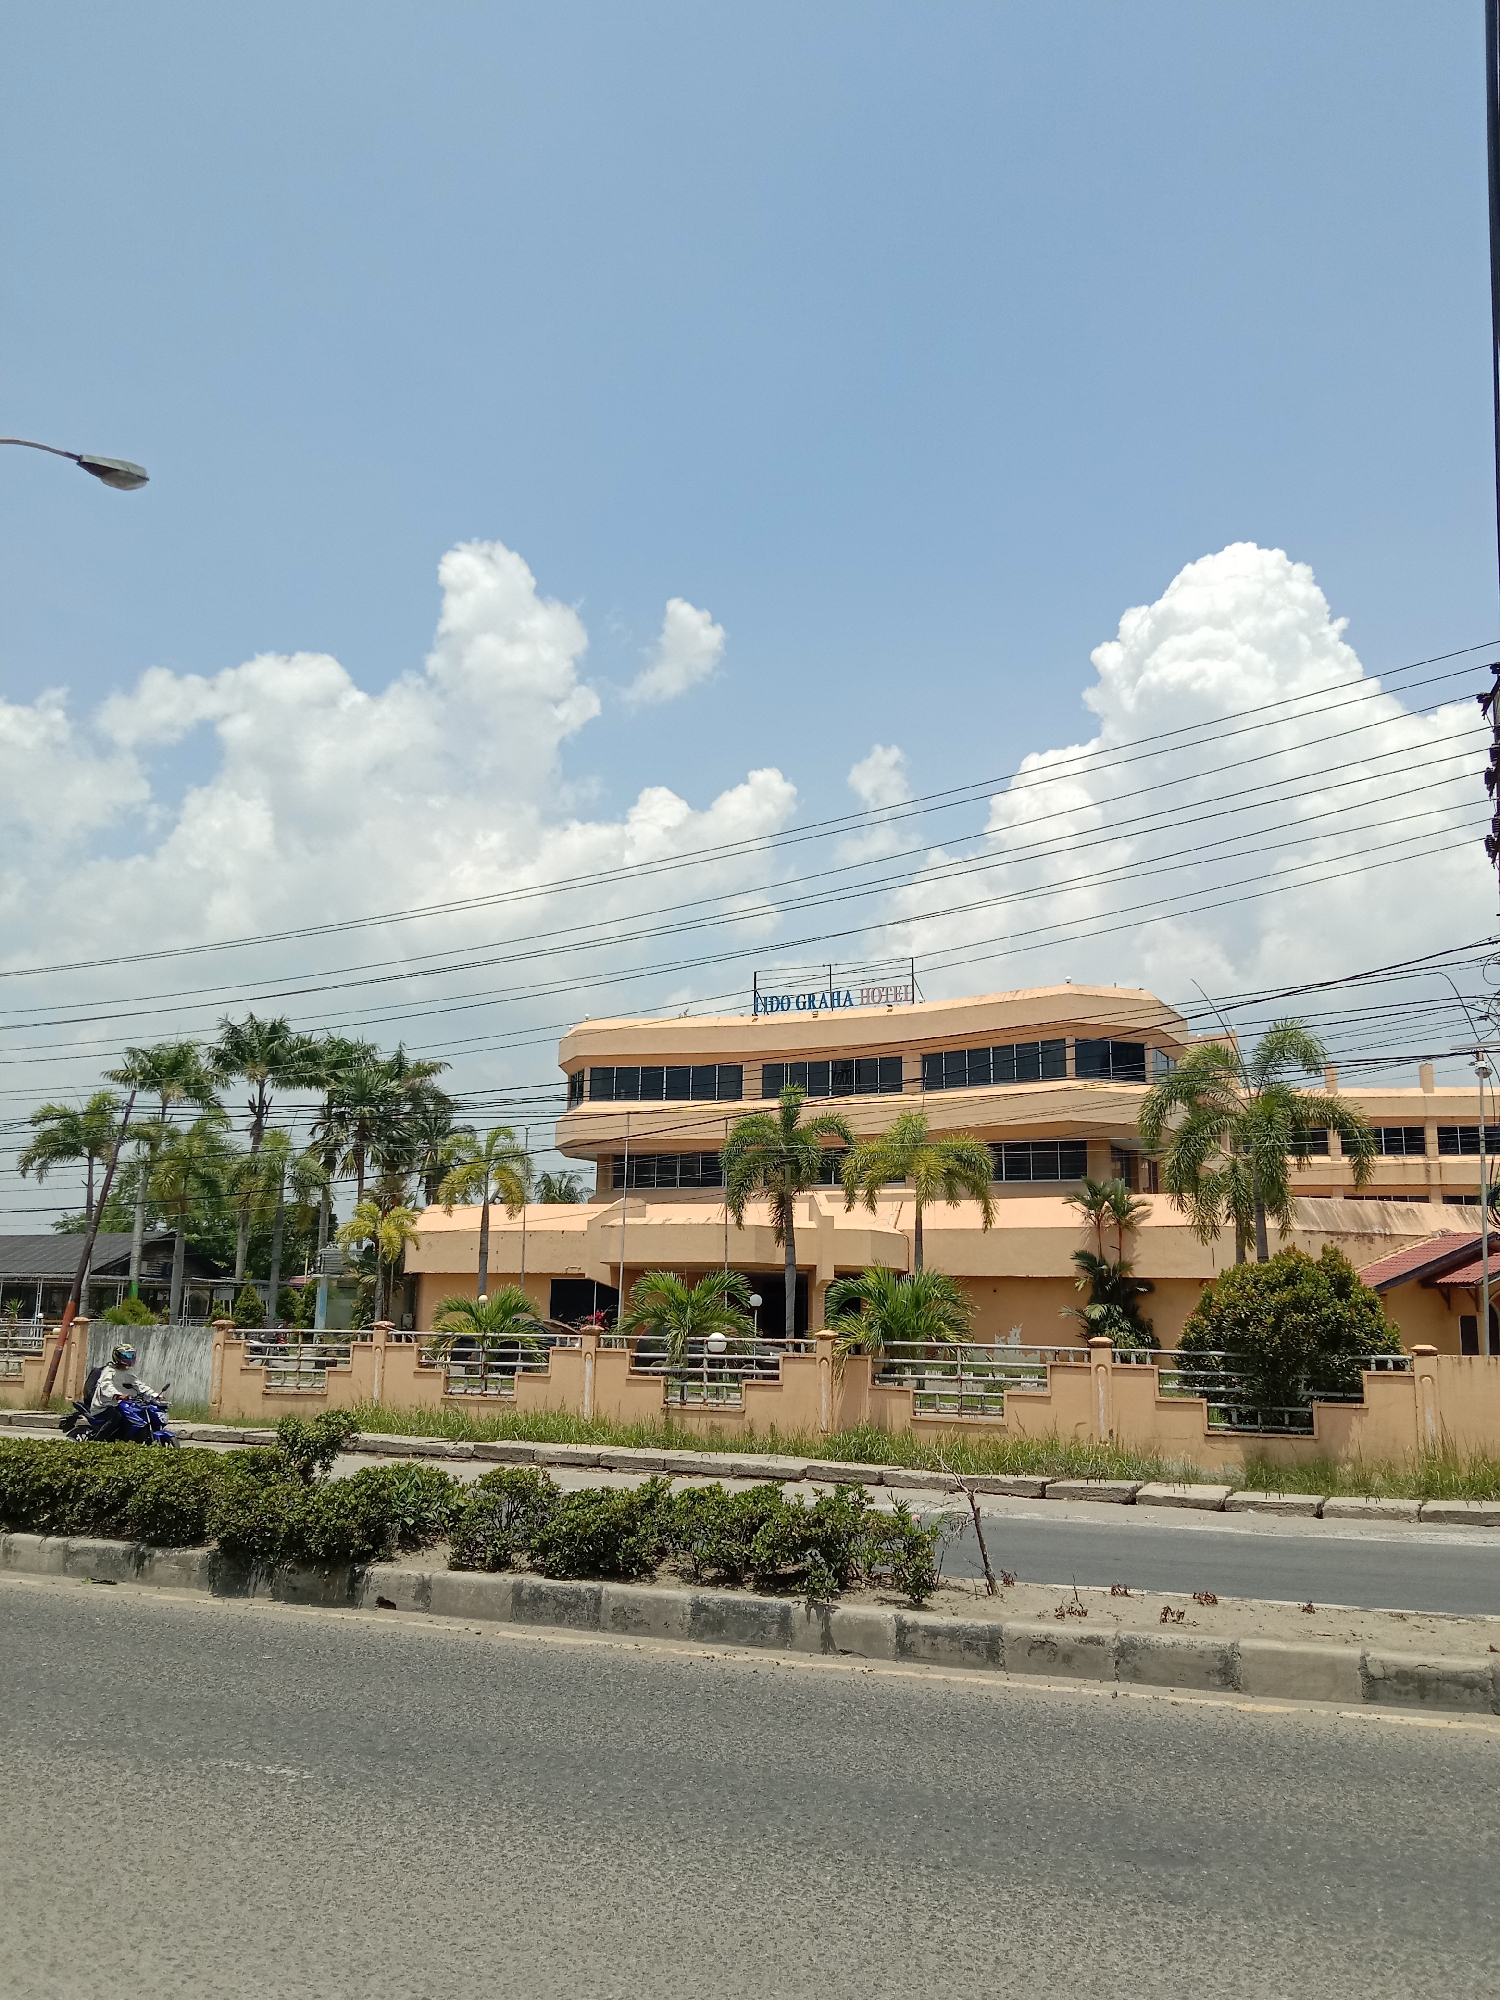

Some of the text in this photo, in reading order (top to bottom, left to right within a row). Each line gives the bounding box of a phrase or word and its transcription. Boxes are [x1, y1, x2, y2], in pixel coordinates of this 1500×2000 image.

[755, 985, 913, 1013] LIDO GRAHA HOTEL
